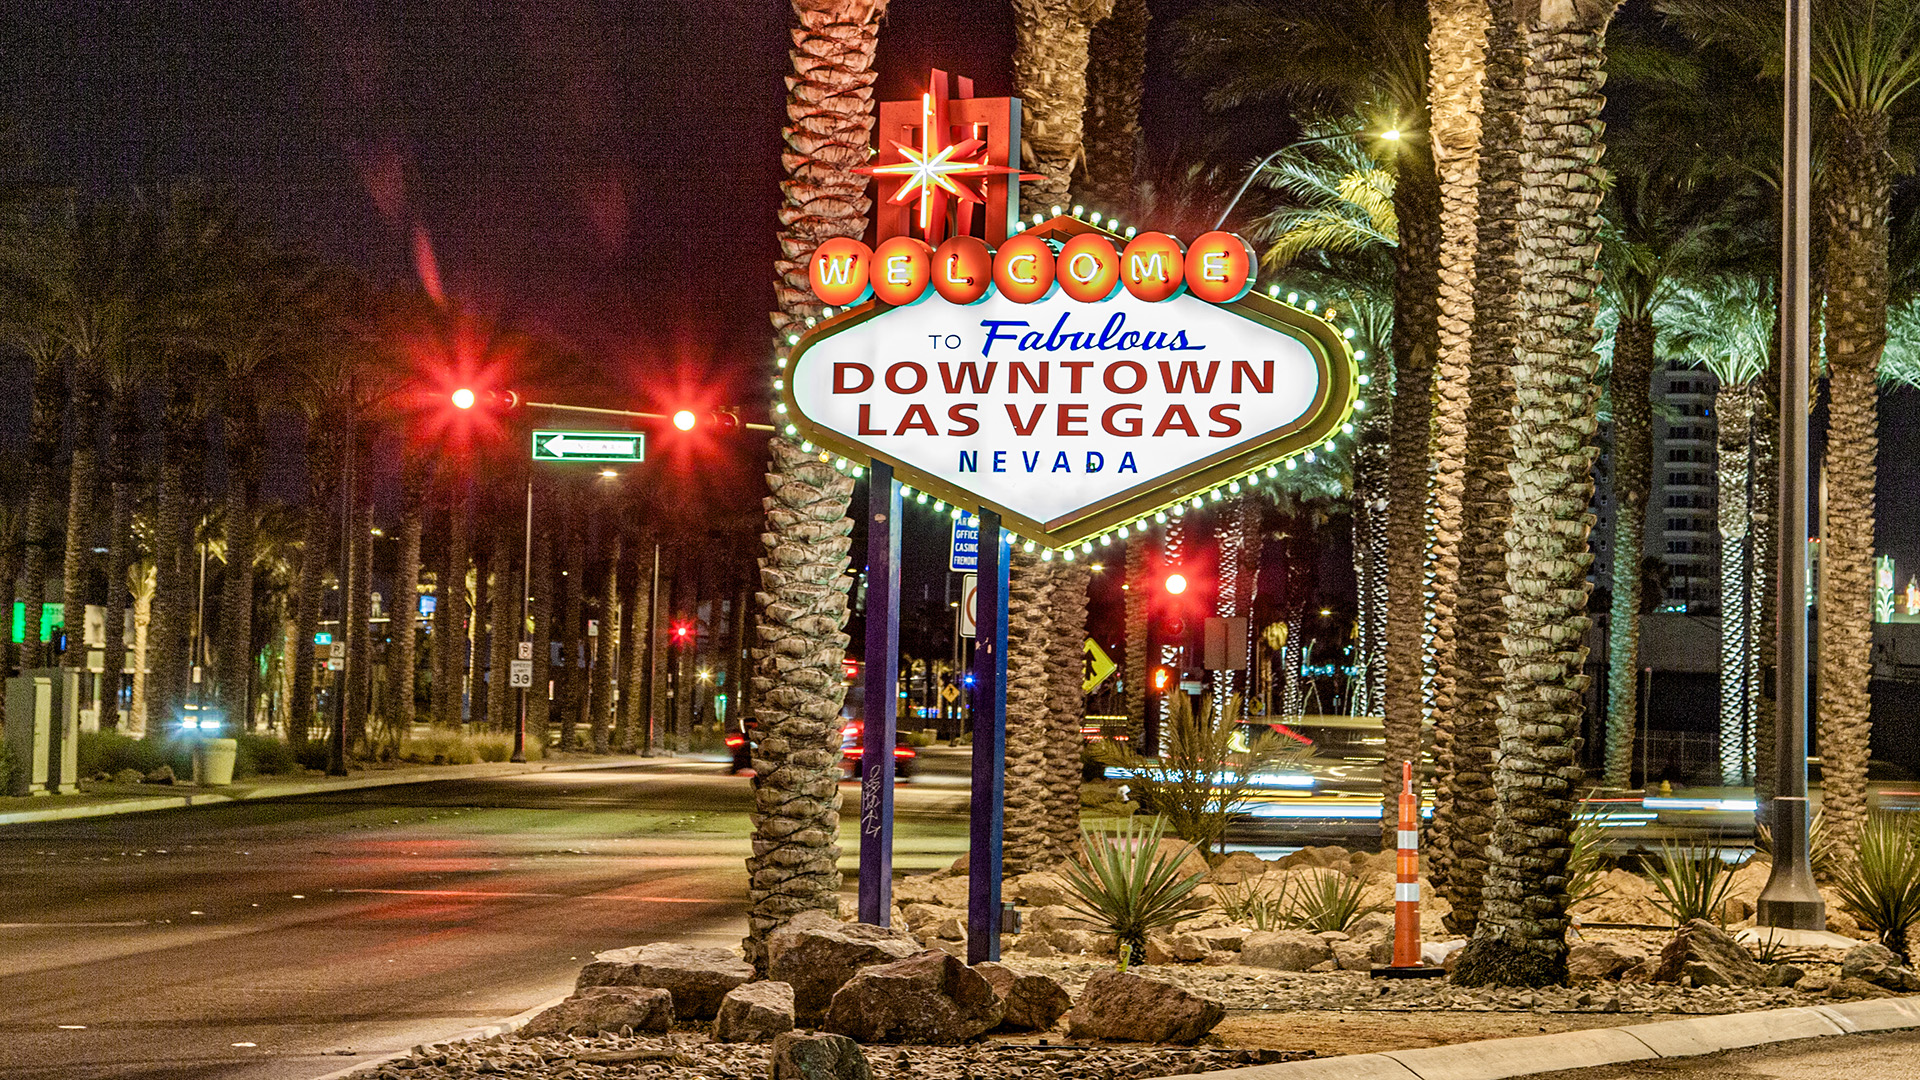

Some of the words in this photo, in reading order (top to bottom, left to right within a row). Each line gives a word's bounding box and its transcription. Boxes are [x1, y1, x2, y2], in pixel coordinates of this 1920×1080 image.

[819, 250, 1230, 286] WELCOME
[929, 334, 962, 350] TO
[980, 311, 1206, 358] Fabulous
[832, 360, 1275, 395] DOWNTOWN
[857, 403, 980, 437] LAS
[1004, 403, 1242, 438] VEGAS
[958, 450, 1138, 474] NEVADA
